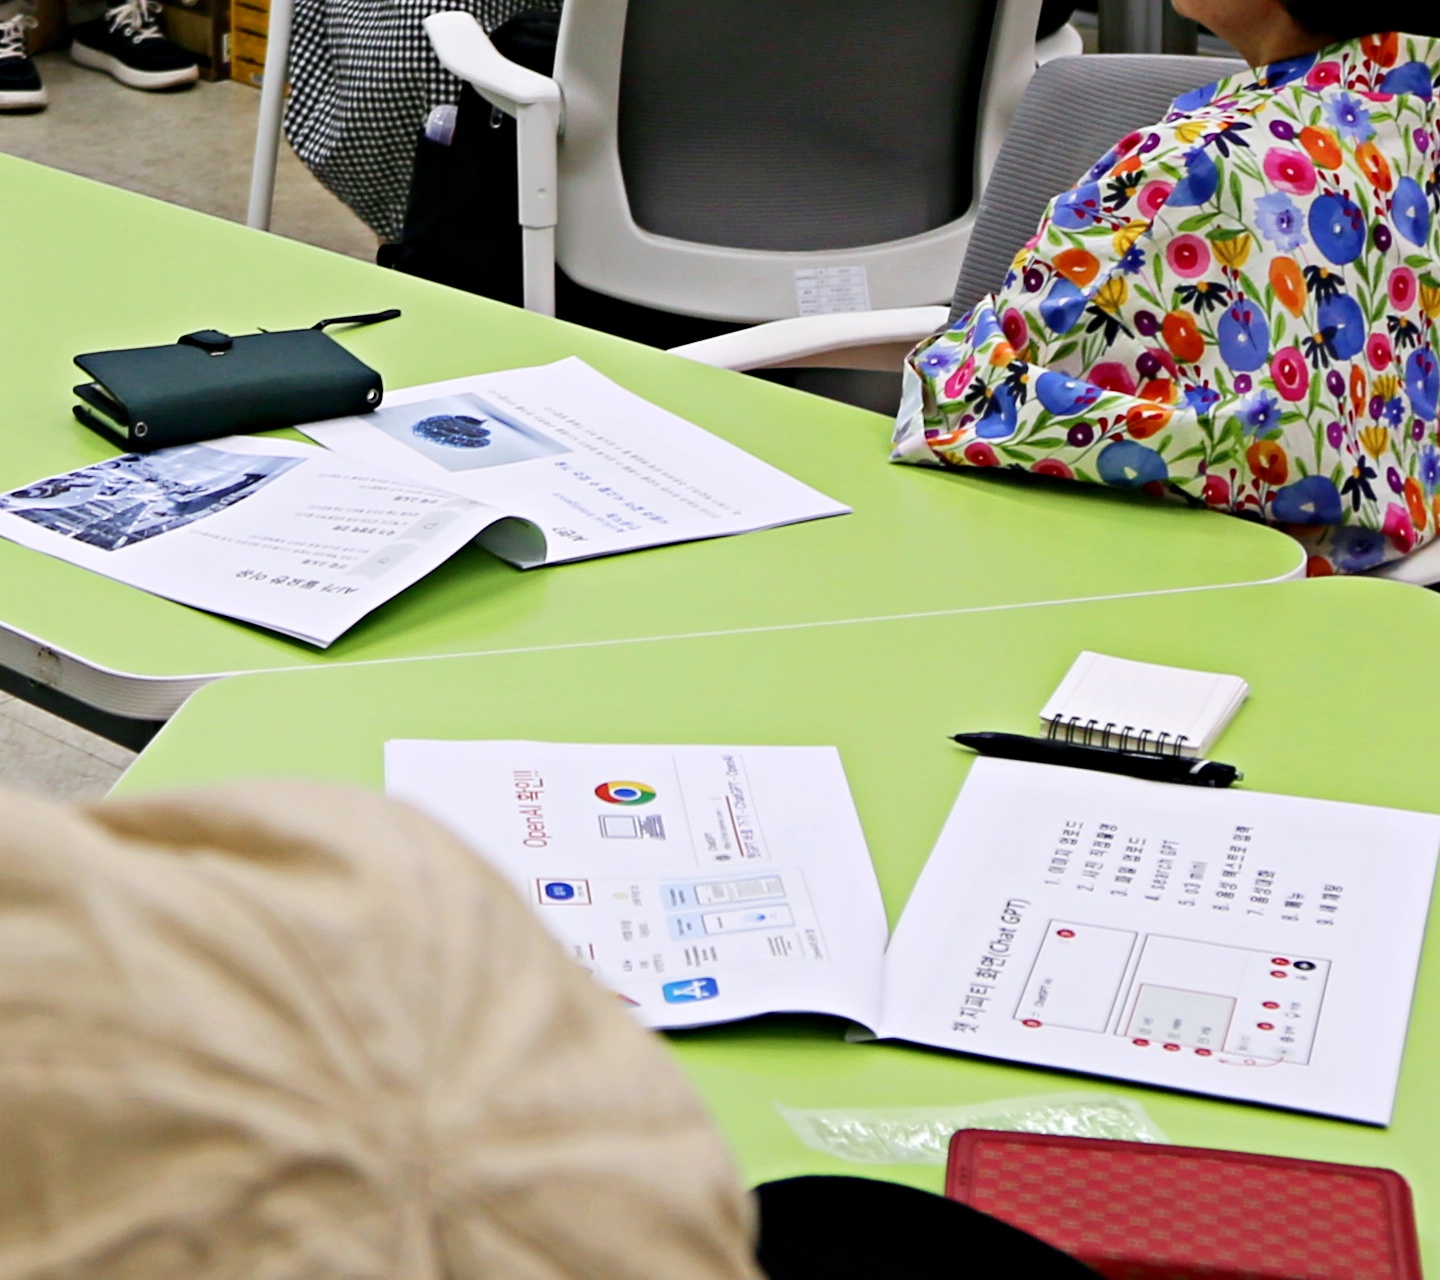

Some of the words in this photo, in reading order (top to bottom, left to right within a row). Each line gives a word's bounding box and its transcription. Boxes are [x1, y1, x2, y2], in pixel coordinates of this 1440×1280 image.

[236, 569, 268, 582] 이유
[270, 575, 320, 592] 필요한
[320, 582, 360, 596] AI가
[519, 804, 553, 849] OpenAI
[1059, 820, 1084, 846] 업로드
[1122, 836, 1148, 863] 업로드
[1159, 839, 1181, 857] GPT
[1048, 849, 1074, 874] 이미지
[1081, 860, 1105, 879] 사진
[1221, 844, 1248, 878] 텍스트로
[1044, 877, 1061, 886] 1.
[1114, 866, 1138, 885] 파일
[1150, 858, 1176, 891] search
[1177, 899, 1196, 907] 5.
[1188, 860, 1208, 880] mini
[1076, 883, 1095, 893] 2.
[1110, 889, 1129, 898] 3.
[1215, 881, 1239, 900] 음성
[1144, 894, 1162, 902] 4.
[1001, 898, 1033, 926] GPT)
[1246, 907, 1265, 917] 7.
[1280, 913, 1300, 923] 8.
[1315, 917, 1335, 926] 9.
[975, 926, 1018, 982] 화면(Chat
[959, 983, 997, 1020] 지피티
[950, 1019, 980, 1034] 챗
